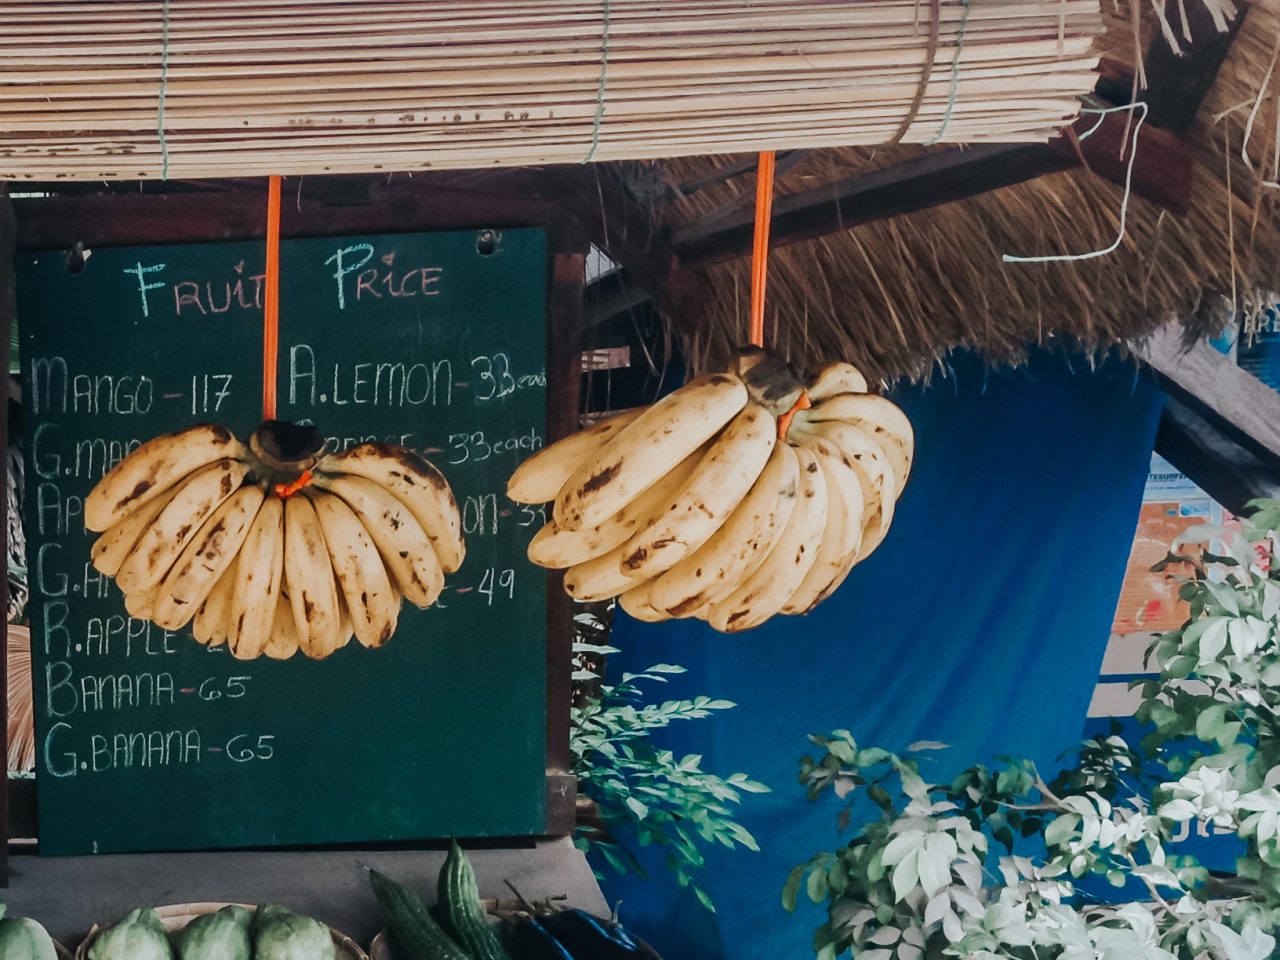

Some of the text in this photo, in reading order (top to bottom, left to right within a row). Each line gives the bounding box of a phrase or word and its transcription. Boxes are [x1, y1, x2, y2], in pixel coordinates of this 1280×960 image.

[325, 243, 443, 309] PRICE
[31, 356, 154, 415] MANGO
[192, 374, 233, 415] 117
[289, 344, 453, 406] A.LEMON
[478, 567, 515, 605] 49
[45, 661, 174, 718] BANANA
[198, 676, 252, 701] 65
[44, 722, 201, 778] G.BANANA
[226, 734, 276, 763] 65
